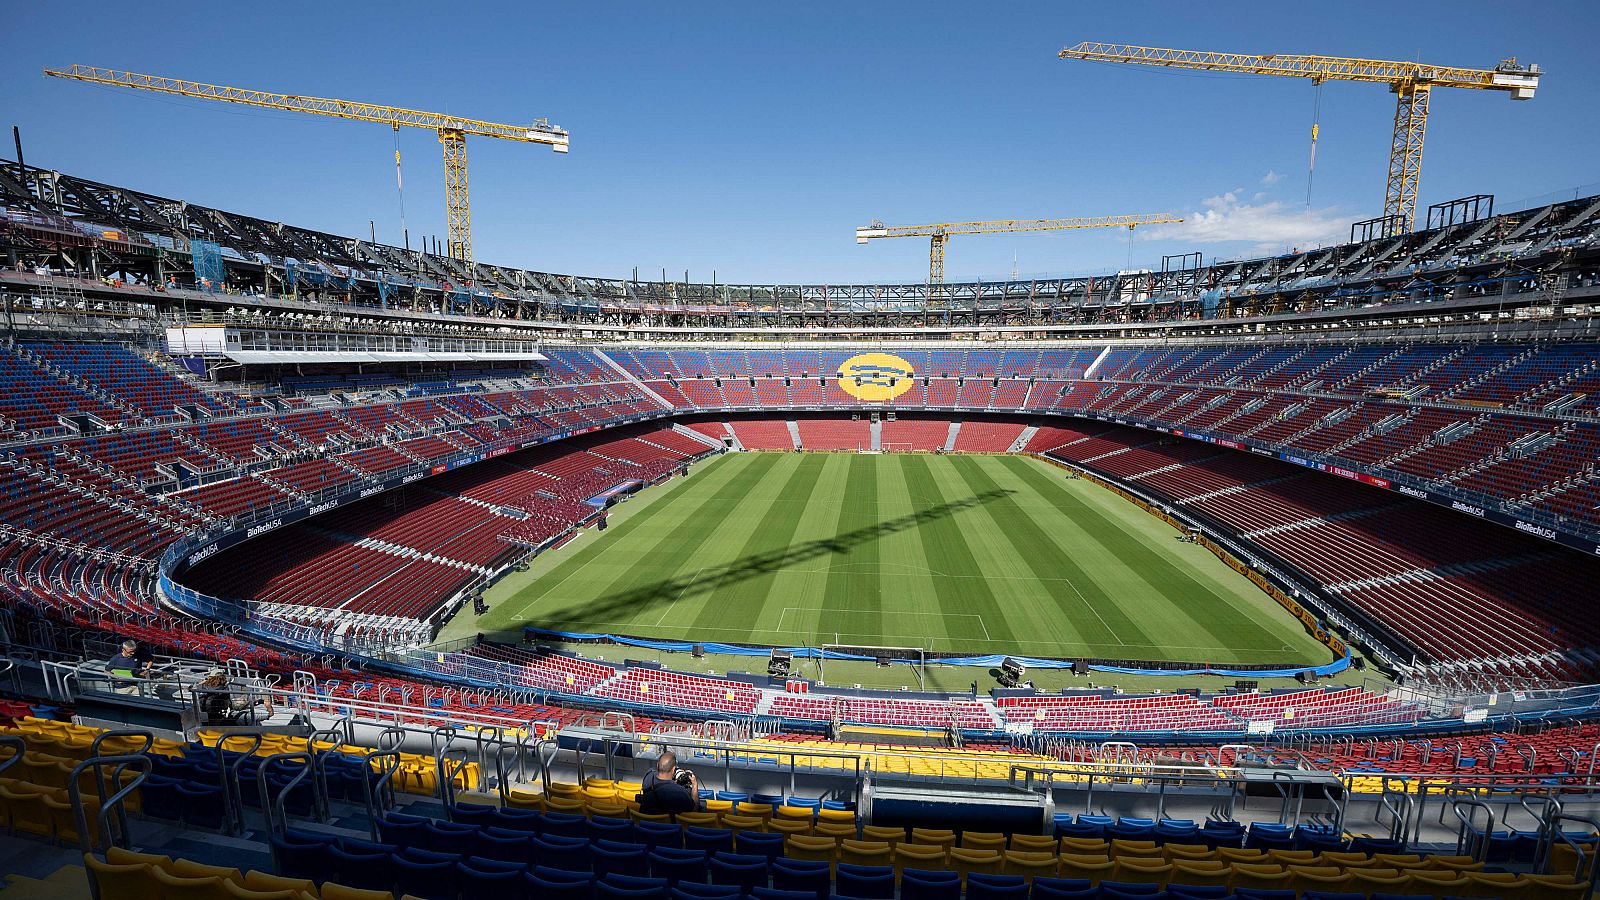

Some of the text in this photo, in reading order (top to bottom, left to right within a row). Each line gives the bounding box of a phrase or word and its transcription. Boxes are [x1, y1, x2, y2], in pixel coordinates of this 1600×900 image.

[360, 484, 385, 498] BioTechUSA
[1399, 485, 1427, 499] BioTechUSA
[309, 499, 339, 516] BioTechUSA
[1452, 500, 1485, 518] BioTechUSA
[247, 518, 282, 538] BioTechUSA
[1515, 520, 1557, 540] BioTechUSA
[188, 542, 219, 567] BioTechUSA
[1275, 592, 1293, 609] STANLEY
